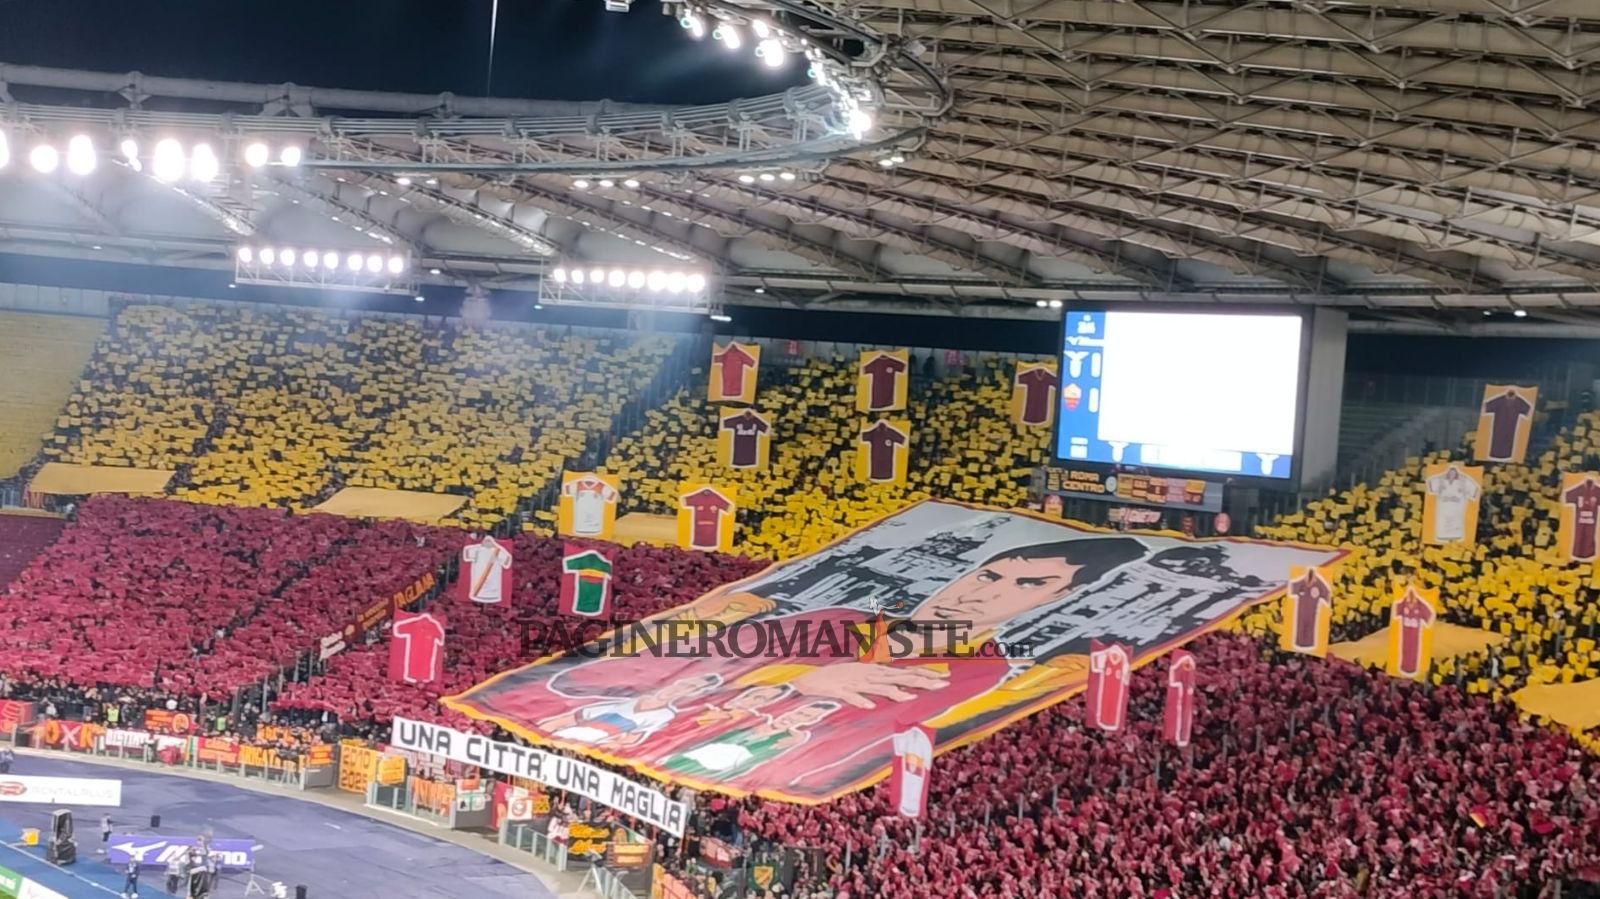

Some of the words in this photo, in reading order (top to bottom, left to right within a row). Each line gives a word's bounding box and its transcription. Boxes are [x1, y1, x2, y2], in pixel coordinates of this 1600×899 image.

[400, 721, 451, 755] UNA
[556, 759, 600, 799] UNA
[610, 776, 682, 832] MAGLIA
